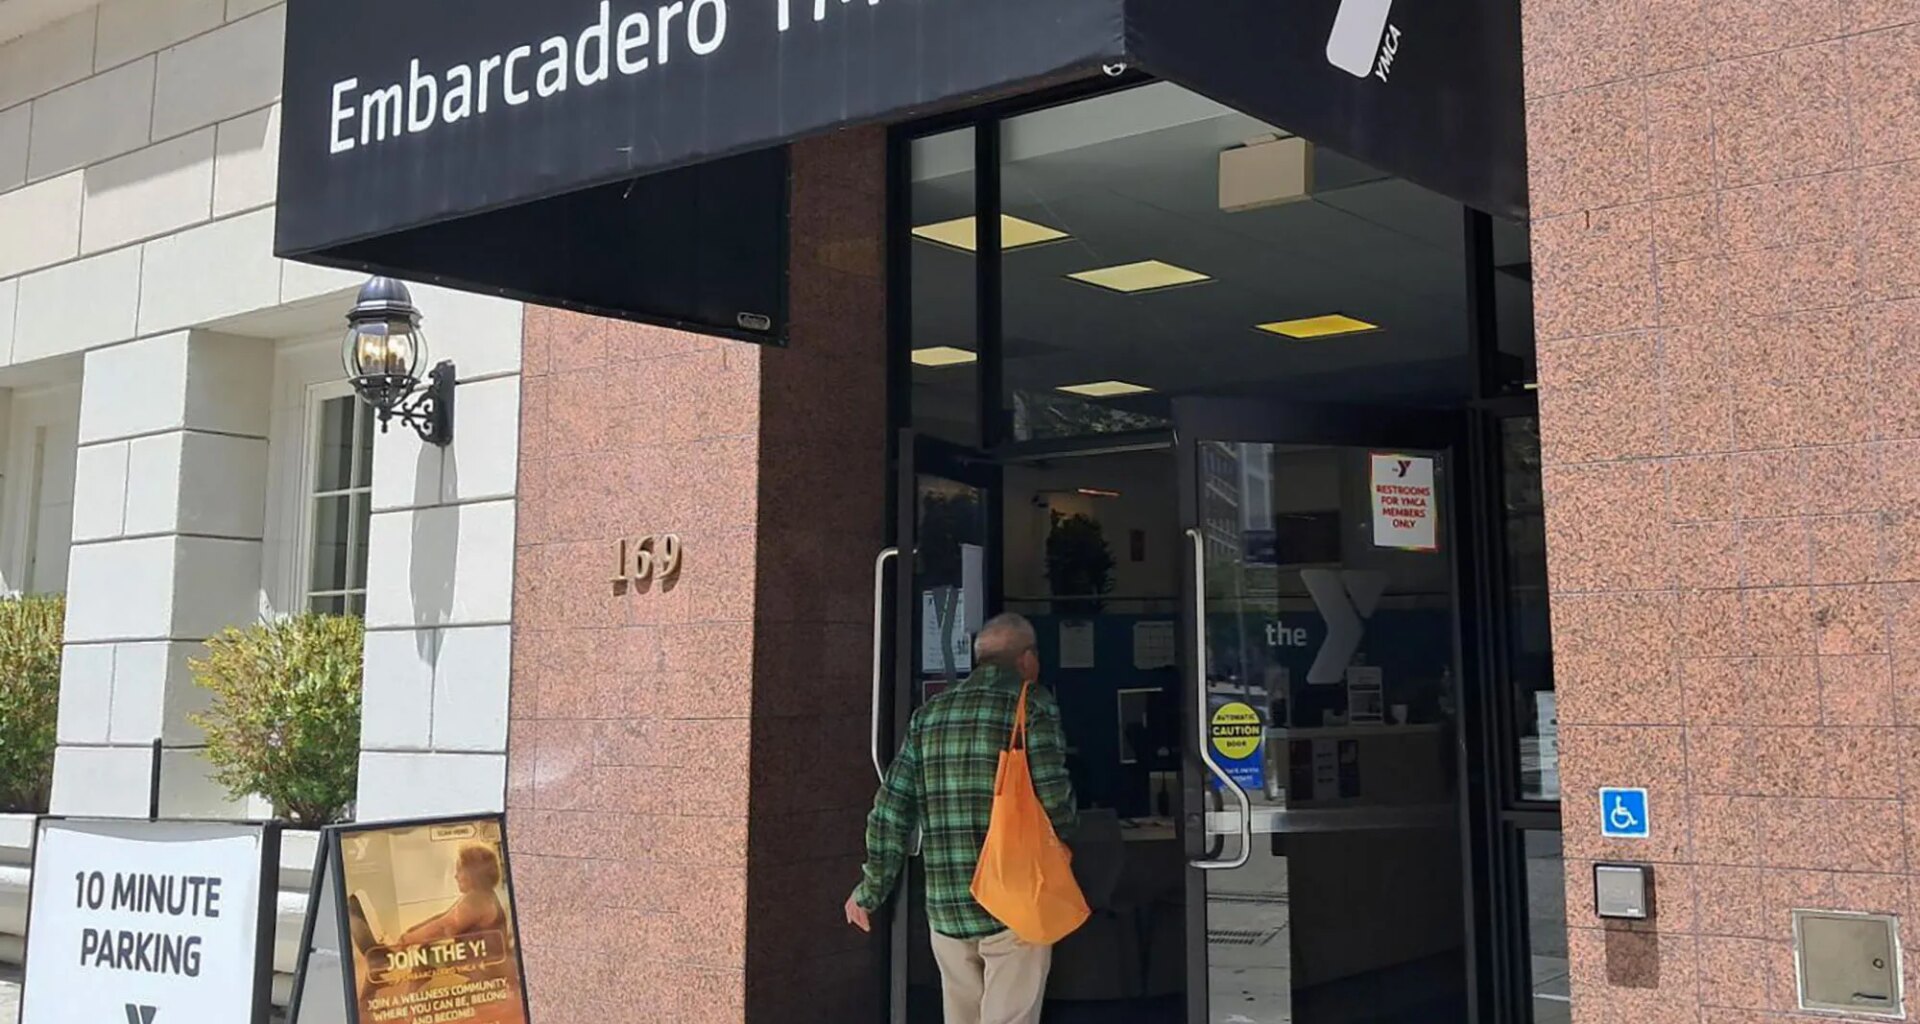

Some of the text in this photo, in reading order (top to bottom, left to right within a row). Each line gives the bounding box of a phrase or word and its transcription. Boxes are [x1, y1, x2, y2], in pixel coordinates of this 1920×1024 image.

[1375, 24, 1401, 82] YMCA
[329, 0, 728, 154] Embarcadero
[1376, 485, 1430, 496] RESTROOMS
[1381, 496, 1426, 507] FOR YMCA
[1382, 508, 1425, 518] MEMBERS
[1392, 519, 1416, 528] ONLY
[608, 533, 682, 581] 169
[1265, 621, 1307, 646] the
[1212, 726, 1260, 736] CAUTION
[75, 870, 222, 918] 10 MINUTE
[80, 928, 202, 977] PARKING
[386, 939, 487, 971] JOIN THE Y!
[367, 998, 390, 1010] JOIN
[392, 997, 401, 1006] A
[401, 988, 450, 1004] WELLNESS
[372, 1007, 409, 1022] WHERE
[410, 1002, 432, 1014] YOU
[433, 999, 455, 1010] CAN
[471, 990, 507, 1005] BELONG
[412, 1013, 434, 1024] AND
